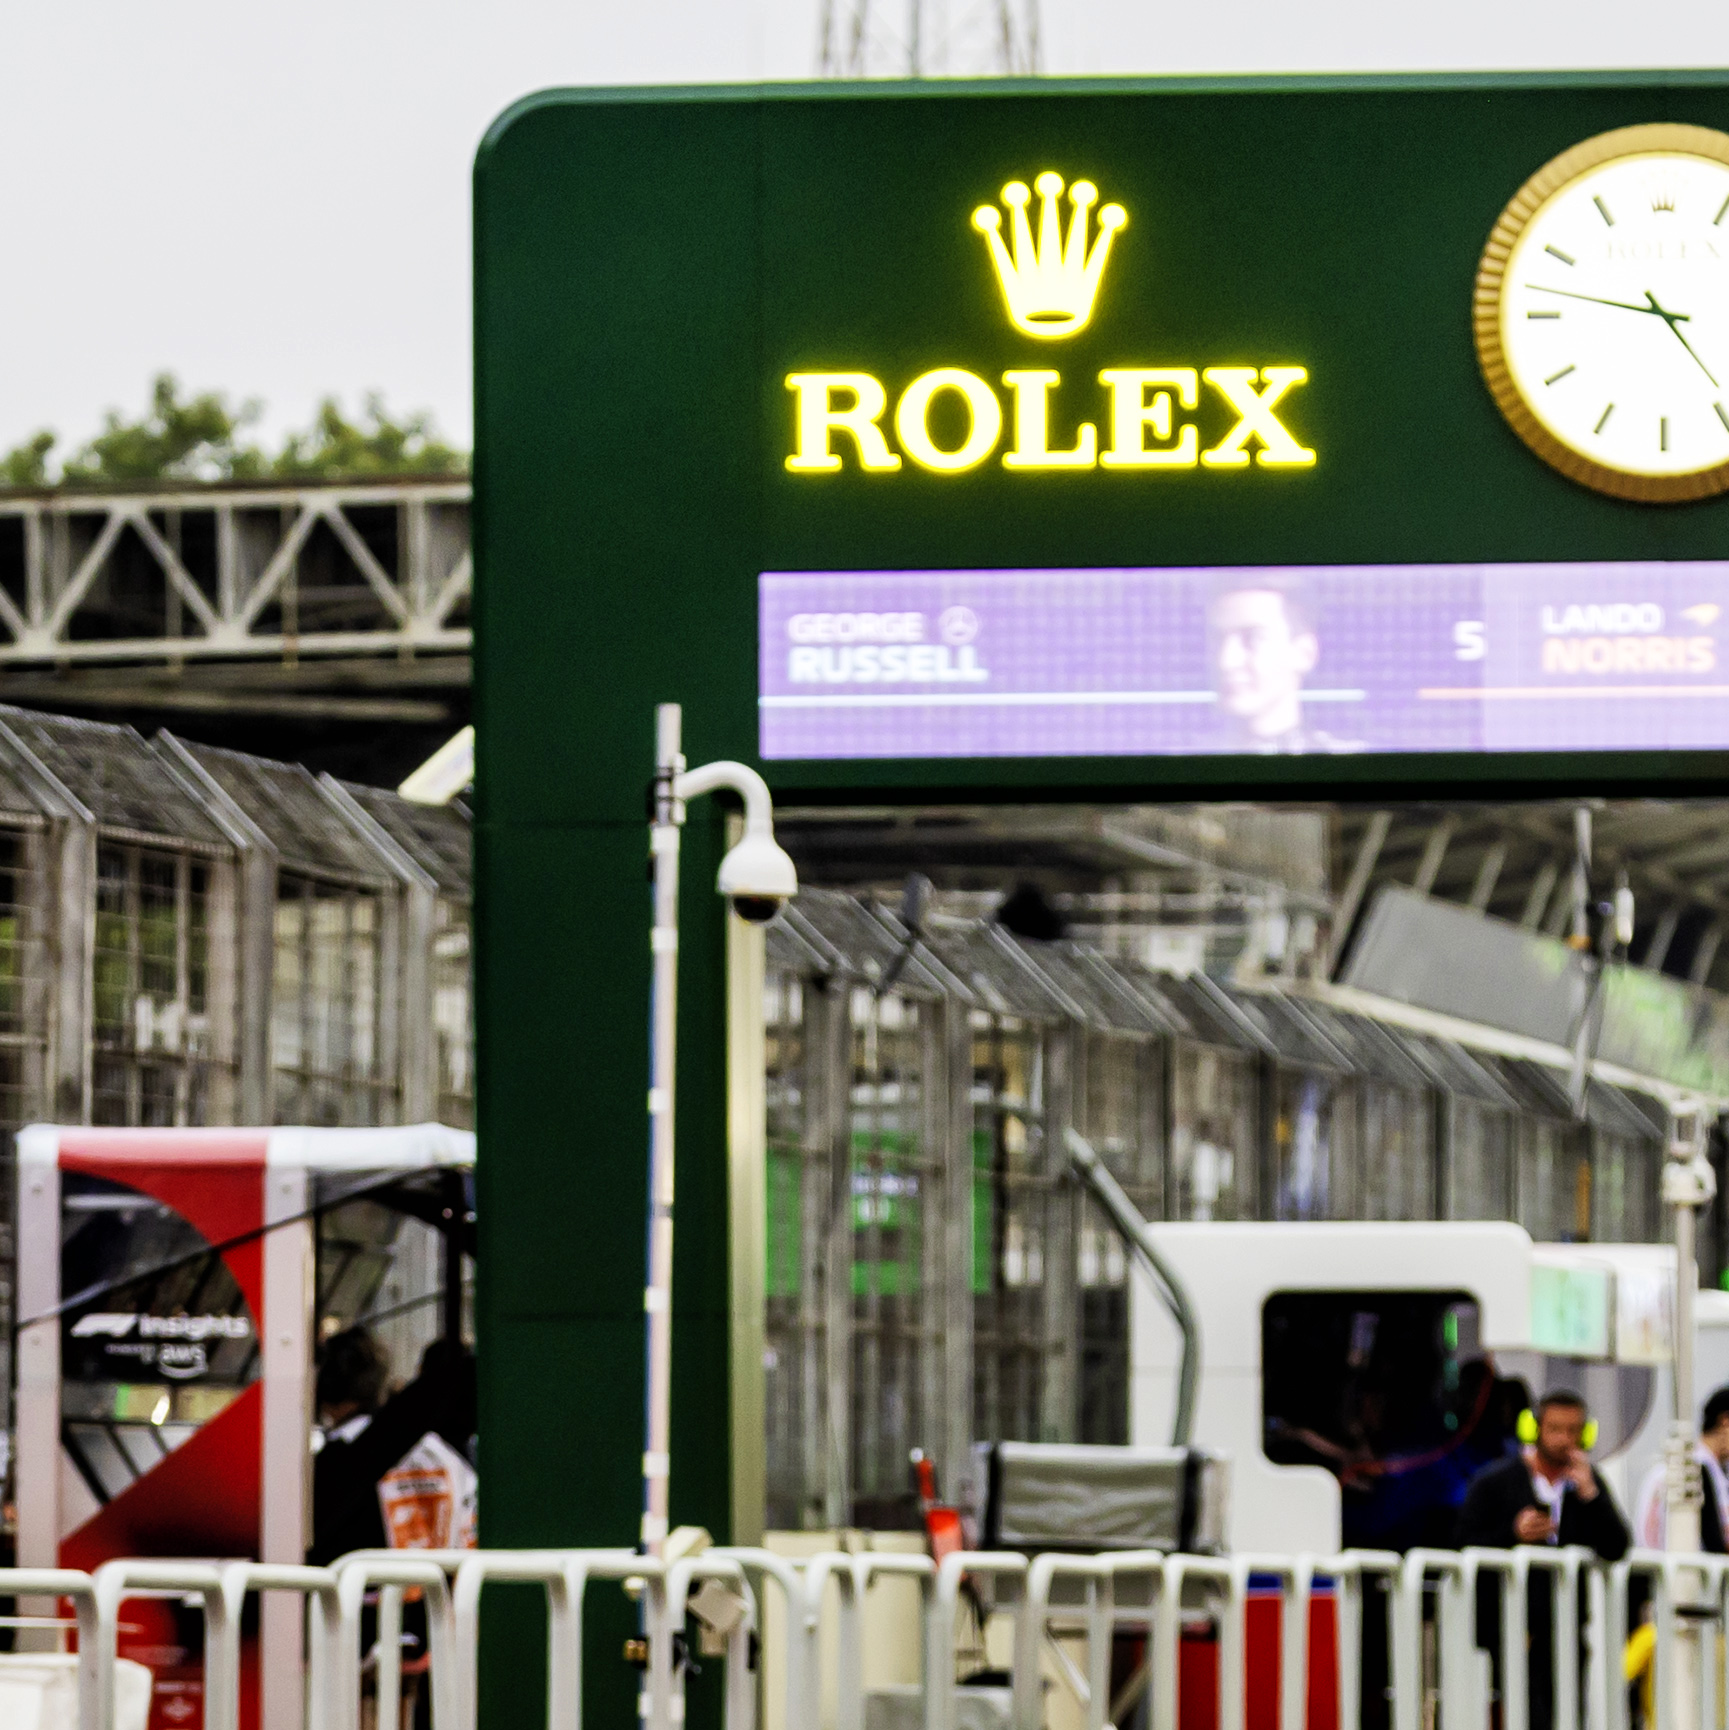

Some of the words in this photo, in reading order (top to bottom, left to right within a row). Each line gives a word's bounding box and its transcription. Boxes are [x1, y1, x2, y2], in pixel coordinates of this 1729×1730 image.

[784, 366, 1317, 472] ROLEX
[787, 612, 925, 643] GEORGE
[1542, 603, 1662, 634] LANDO
[1454, 620, 1486, 661] 5
[1541, 637, 1715, 675] NORRIS
[788, 645, 989, 683] RUSSELL
